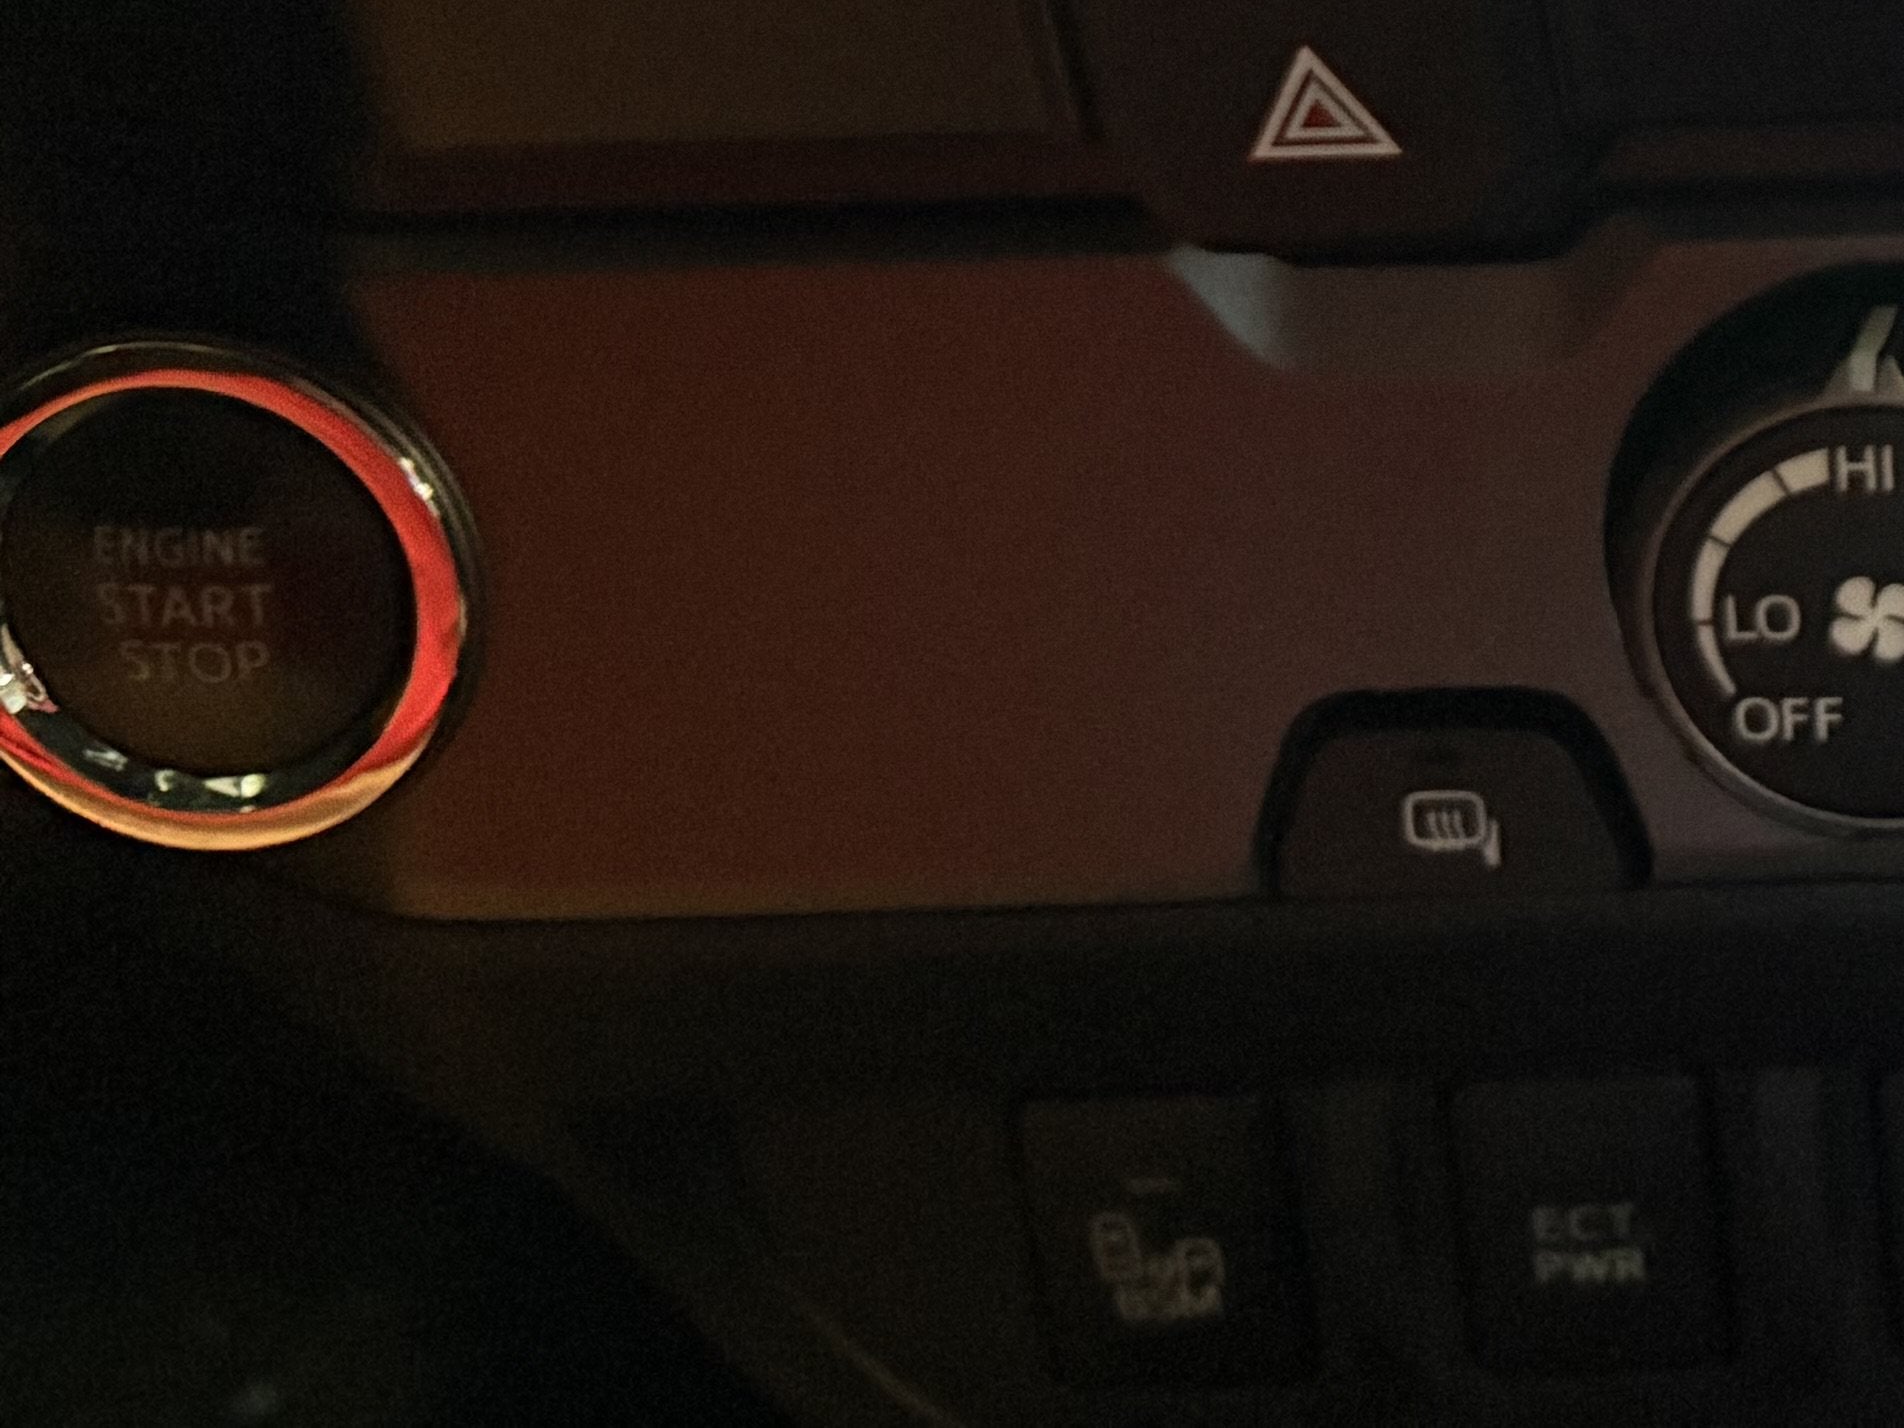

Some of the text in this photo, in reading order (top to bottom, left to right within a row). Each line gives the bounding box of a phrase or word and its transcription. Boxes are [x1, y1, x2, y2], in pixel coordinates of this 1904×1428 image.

[1834, 445, 1896, 492] HI
[94, 525, 265, 567] ENGINE
[96, 581, 274, 629] START
[1725, 594, 1801, 642] LO
[118, 639, 270, 684] STOP
[1735, 696, 1843, 743] OFF
